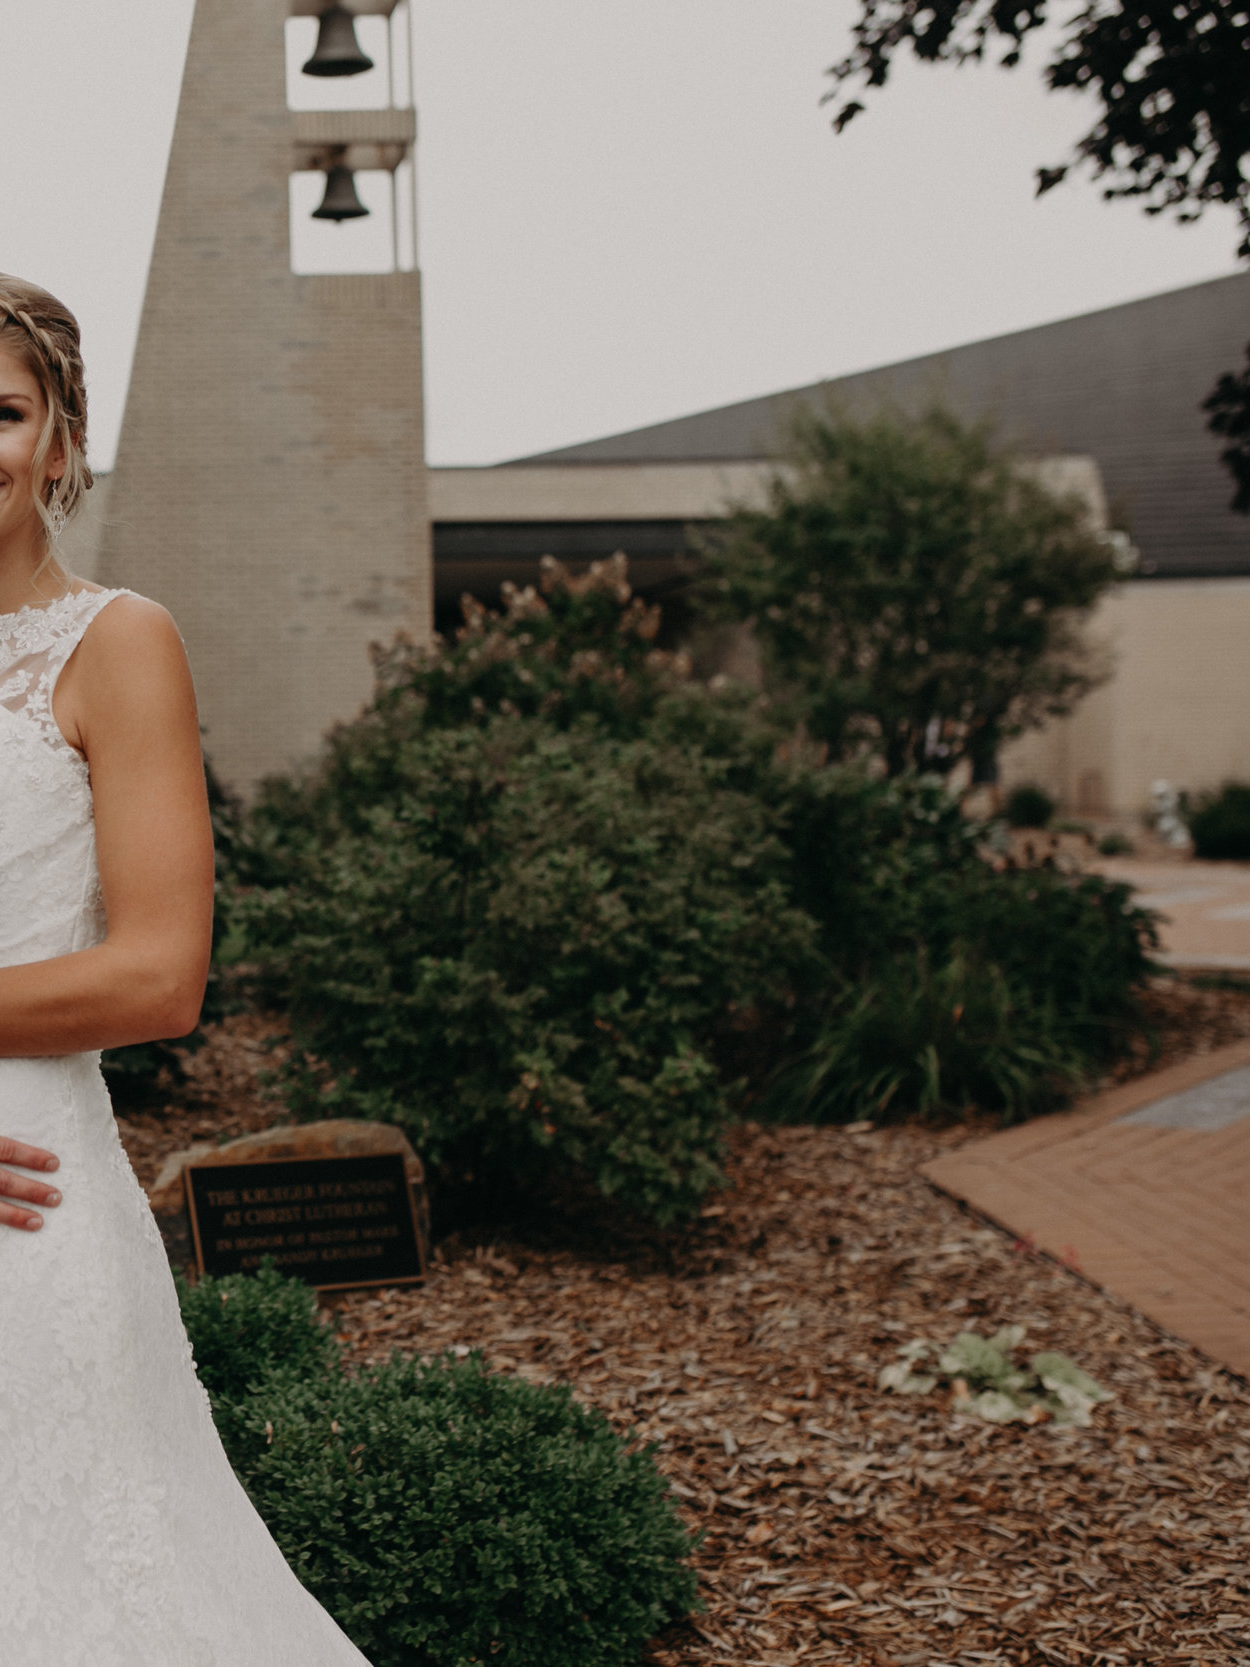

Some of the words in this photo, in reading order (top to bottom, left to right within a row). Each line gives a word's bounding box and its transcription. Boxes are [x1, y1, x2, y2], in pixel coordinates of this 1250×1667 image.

[206, 1191, 238, 1206] THE
[223, 1211, 241, 1226] AT
[244, 1207, 301, 1224] CHRIST
[305, 1201, 387, 1220] LUTHERAN
